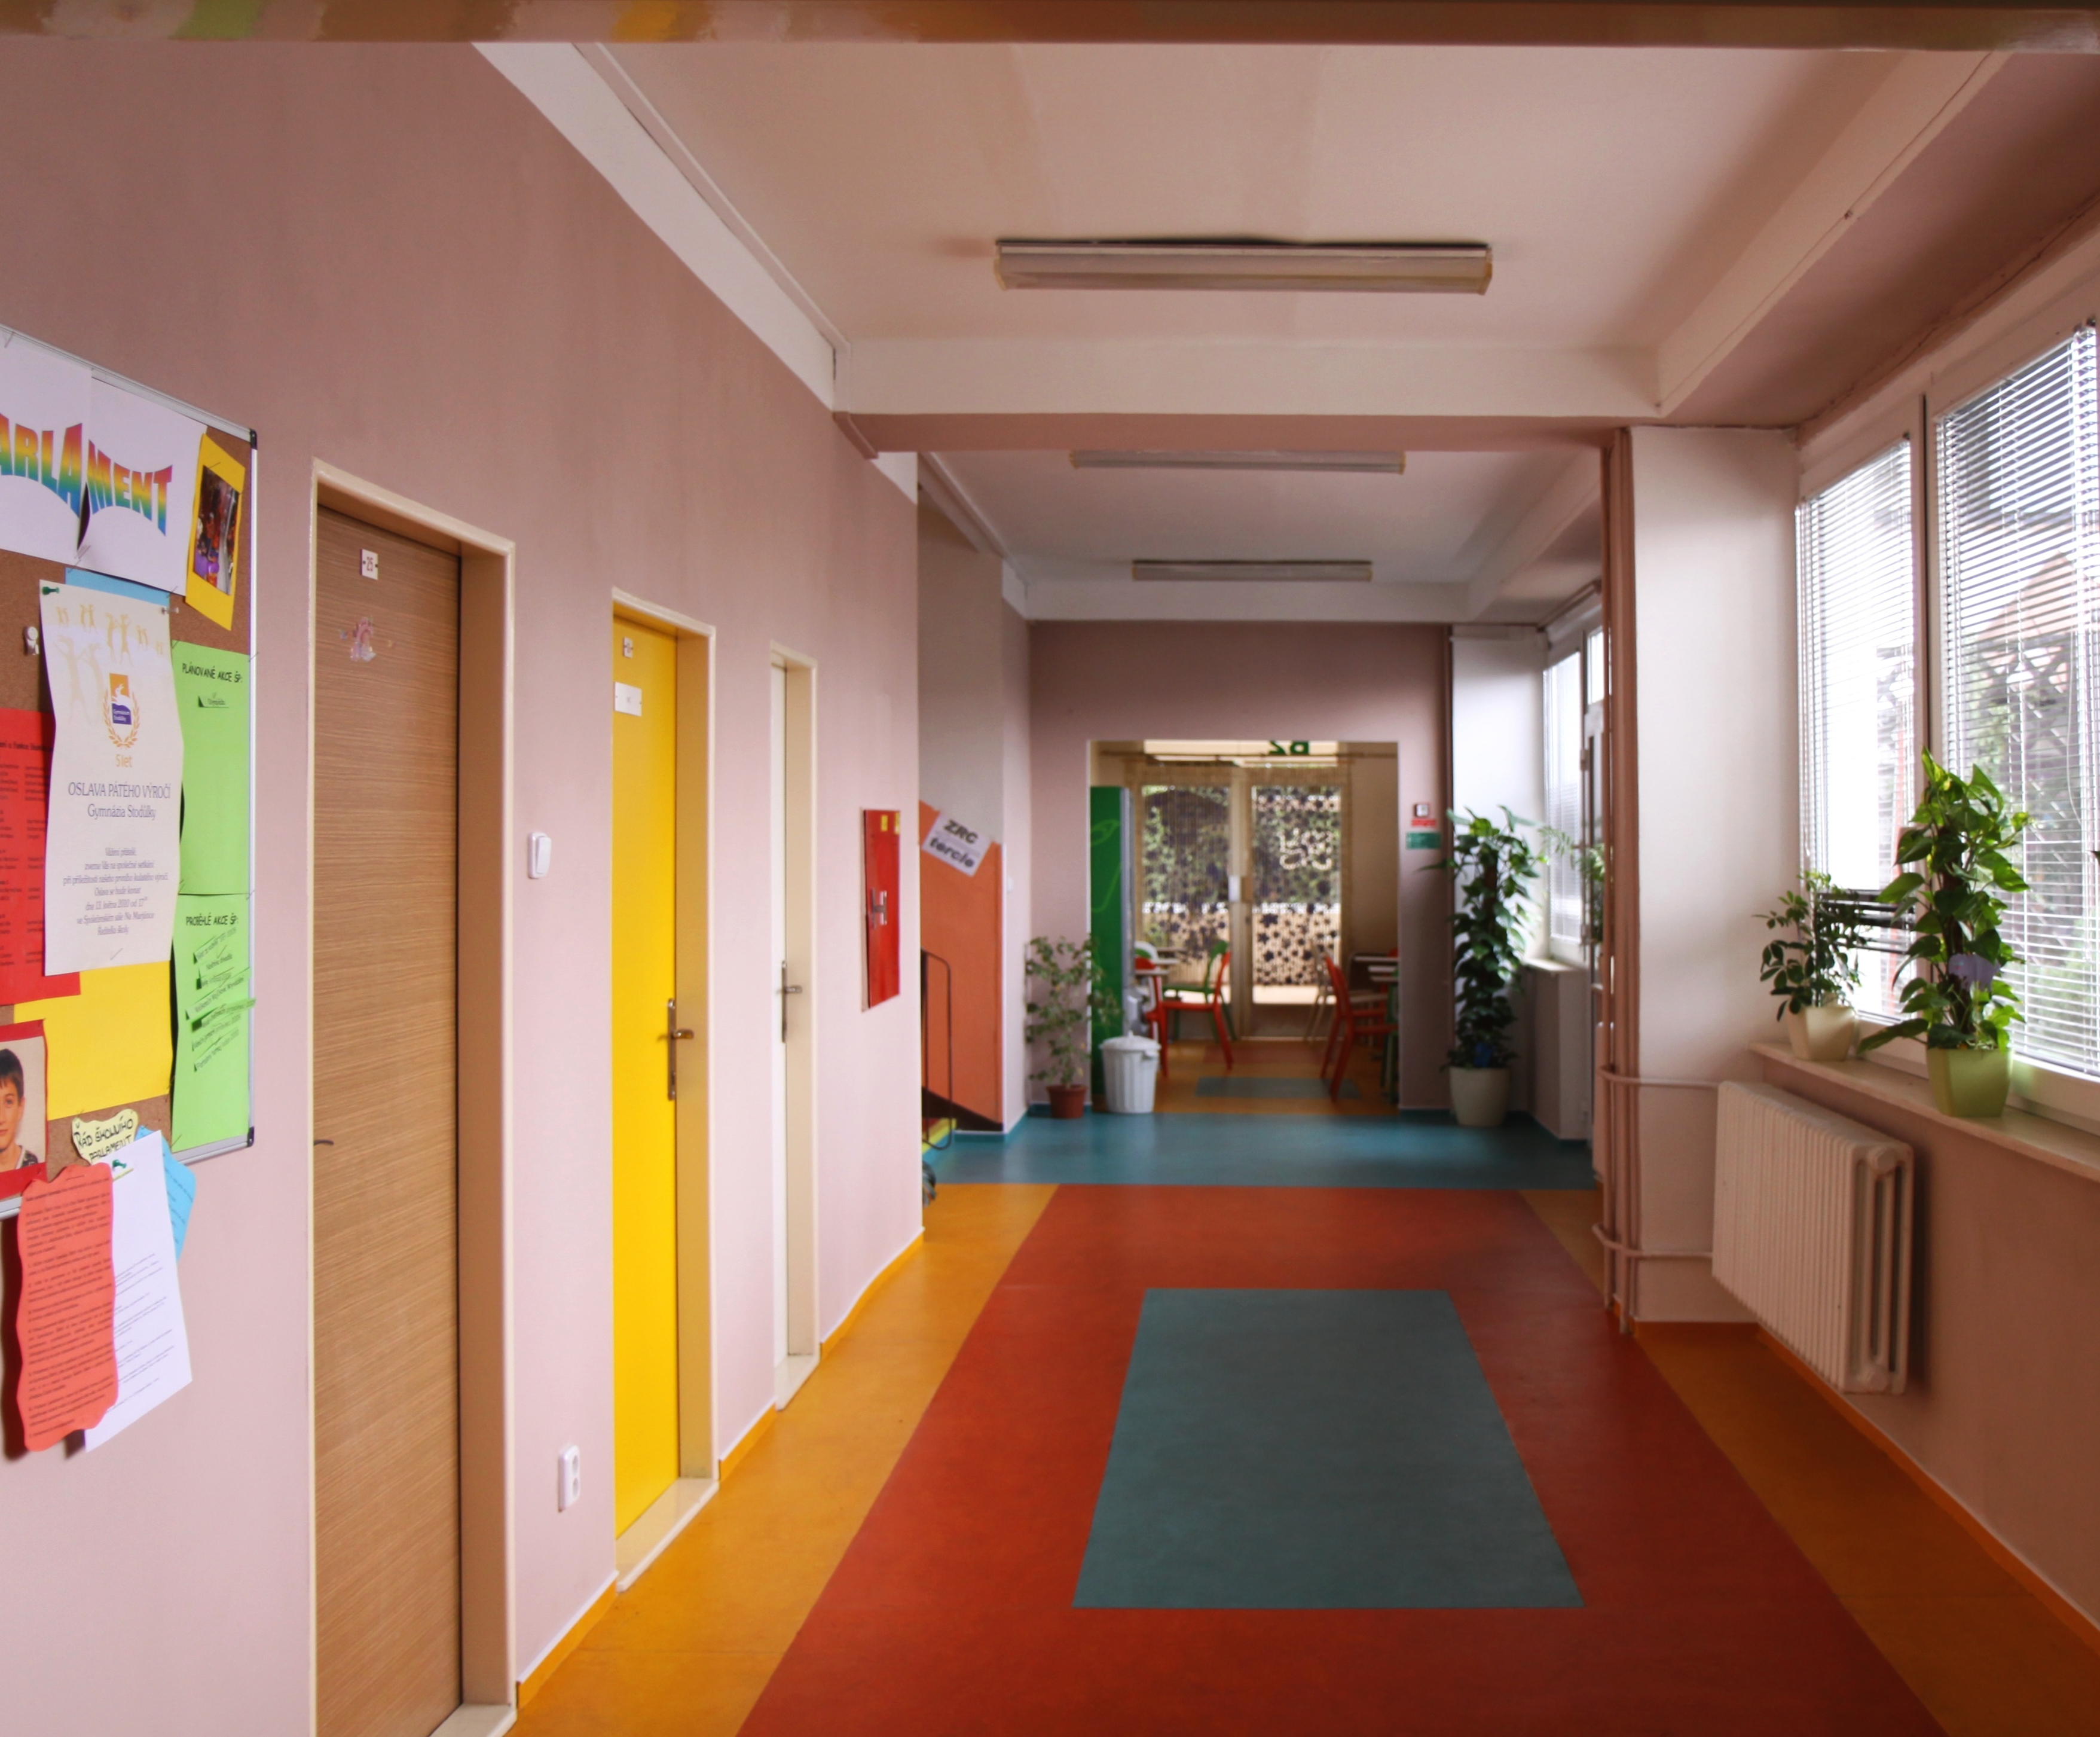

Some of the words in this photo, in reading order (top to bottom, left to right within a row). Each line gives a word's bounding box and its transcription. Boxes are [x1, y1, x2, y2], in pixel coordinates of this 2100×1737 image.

[182, 661, 216, 679] PLÁNOVANÉ
[217, 670, 233, 682] AKCE
[68, 782, 106, 797] OSLAVA
[108, 780, 141, 798] PÁTÉHO
[142, 782, 172, 799] VÝROČÍ
[87, 803, 126, 820] Gymnázia
[127, 804, 157, 821] Stodůlky
[943, 819, 979, 844] ZRC
[213, 915, 228, 926] AKCE
[74, 1122, 93, 1150] ŘÁD
